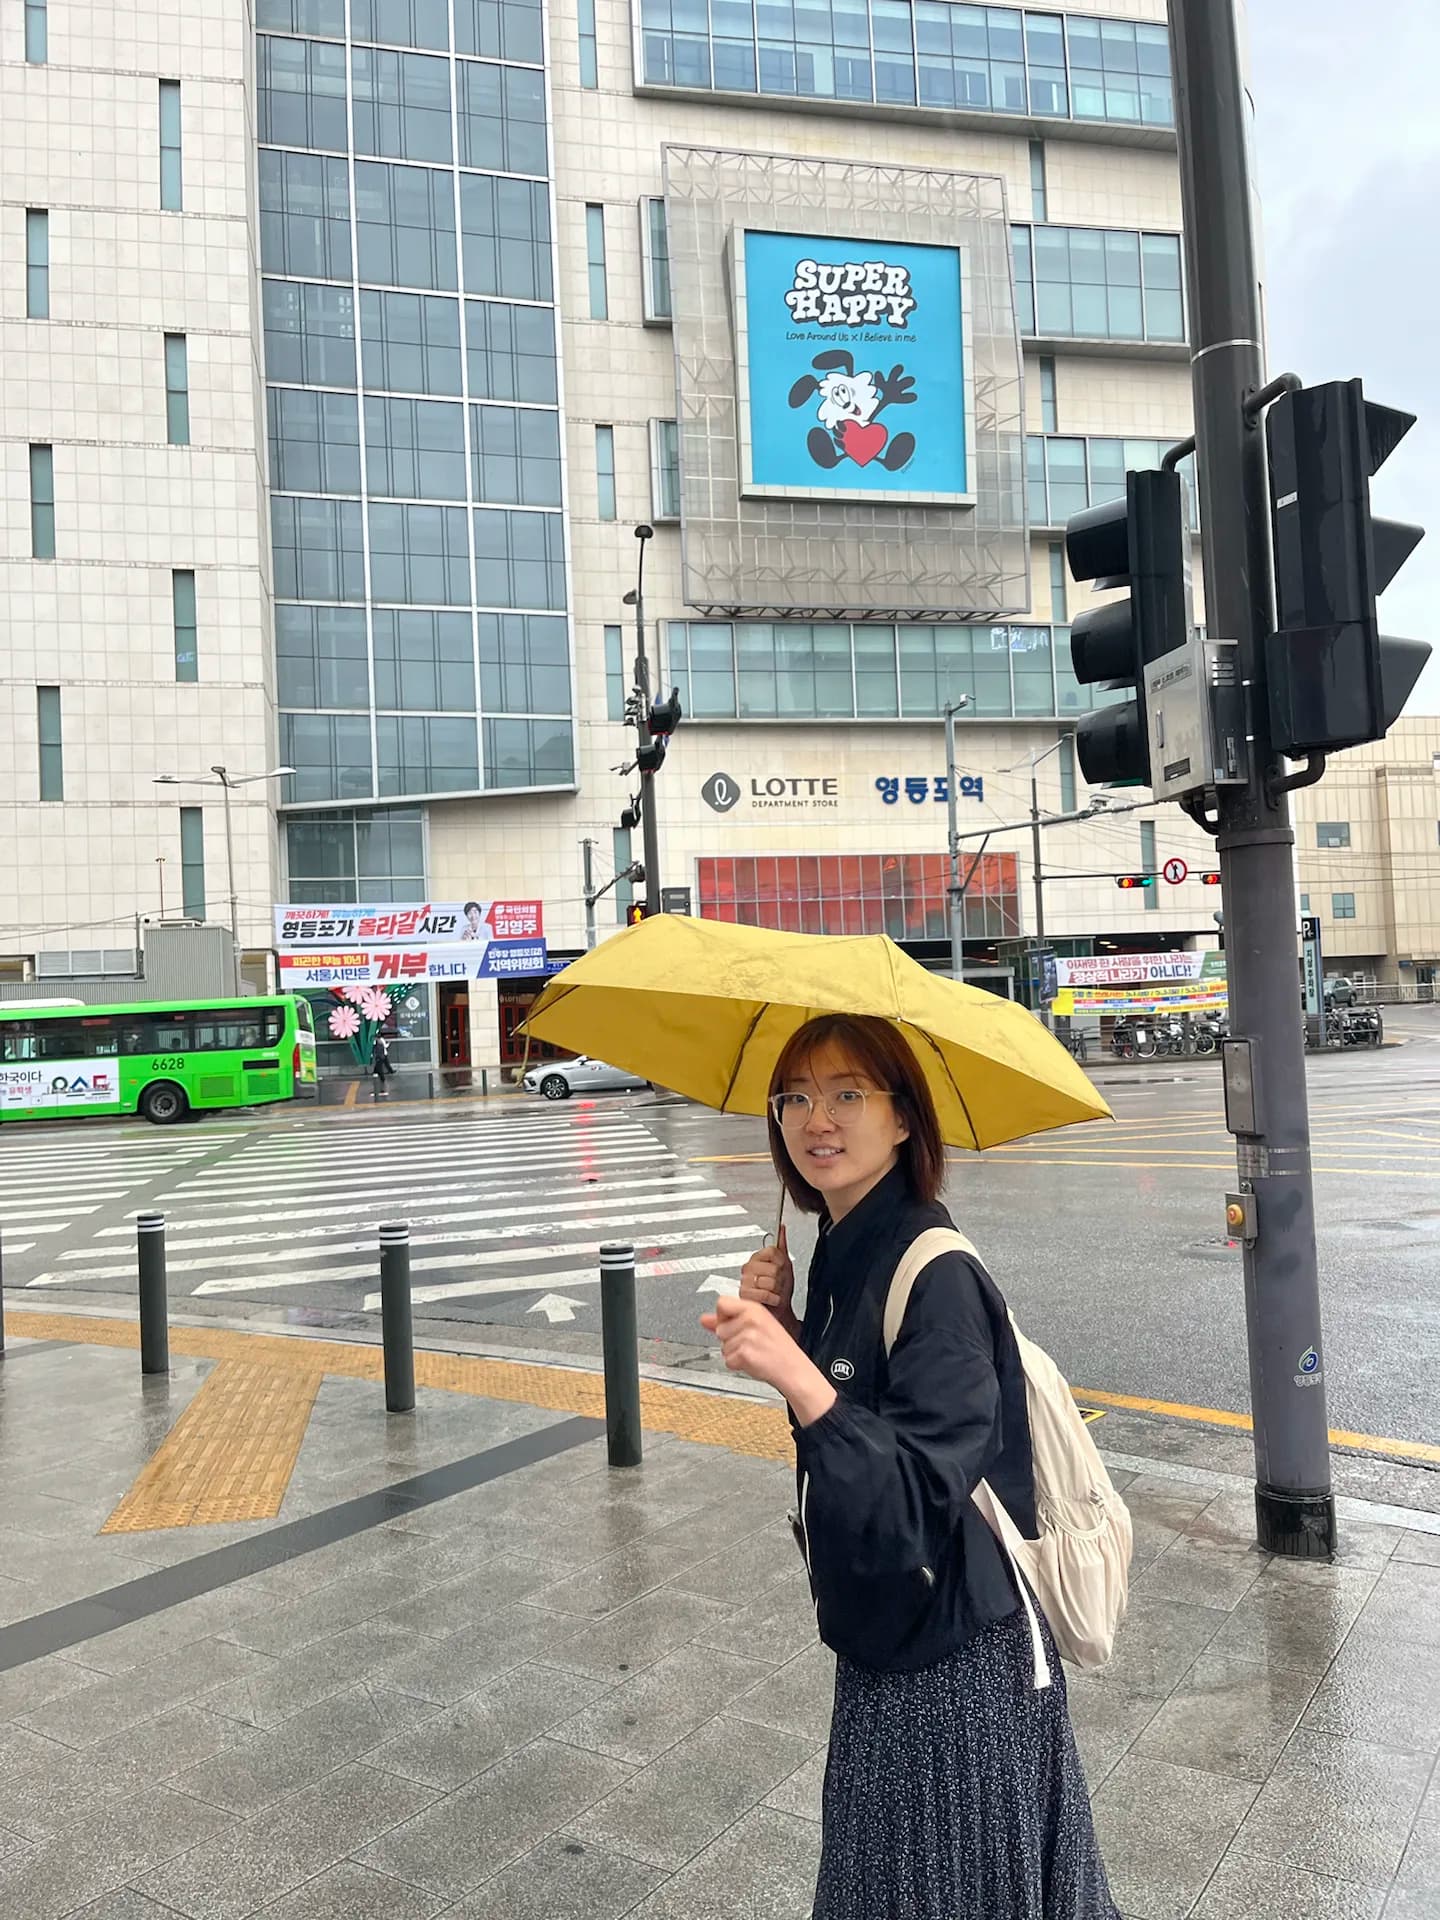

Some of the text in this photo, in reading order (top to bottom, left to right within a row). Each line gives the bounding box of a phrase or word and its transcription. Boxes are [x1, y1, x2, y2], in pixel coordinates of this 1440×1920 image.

[794, 258, 912, 296] SUPER
[784, 289, 917, 328] HAPPY
[786, 331, 806, 341] Love
[807, 331, 837, 341] Around
[838, 332, 849, 341] Us
[864, 333, 892, 342] Believe
[895, 333, 903, 342] in
[751, 778, 838, 796] LOTTE
[752, 800, 809, 808] DEPARTMENT
[282, 911, 456, 939] 영등포가 올라갈 시간
[495, 919, 537, 935] 김영주
[1302, 921, 1311, 938] P
[306, 967, 371, 982] 서울시민은
[152, 1058, 184, 1070] 6628
